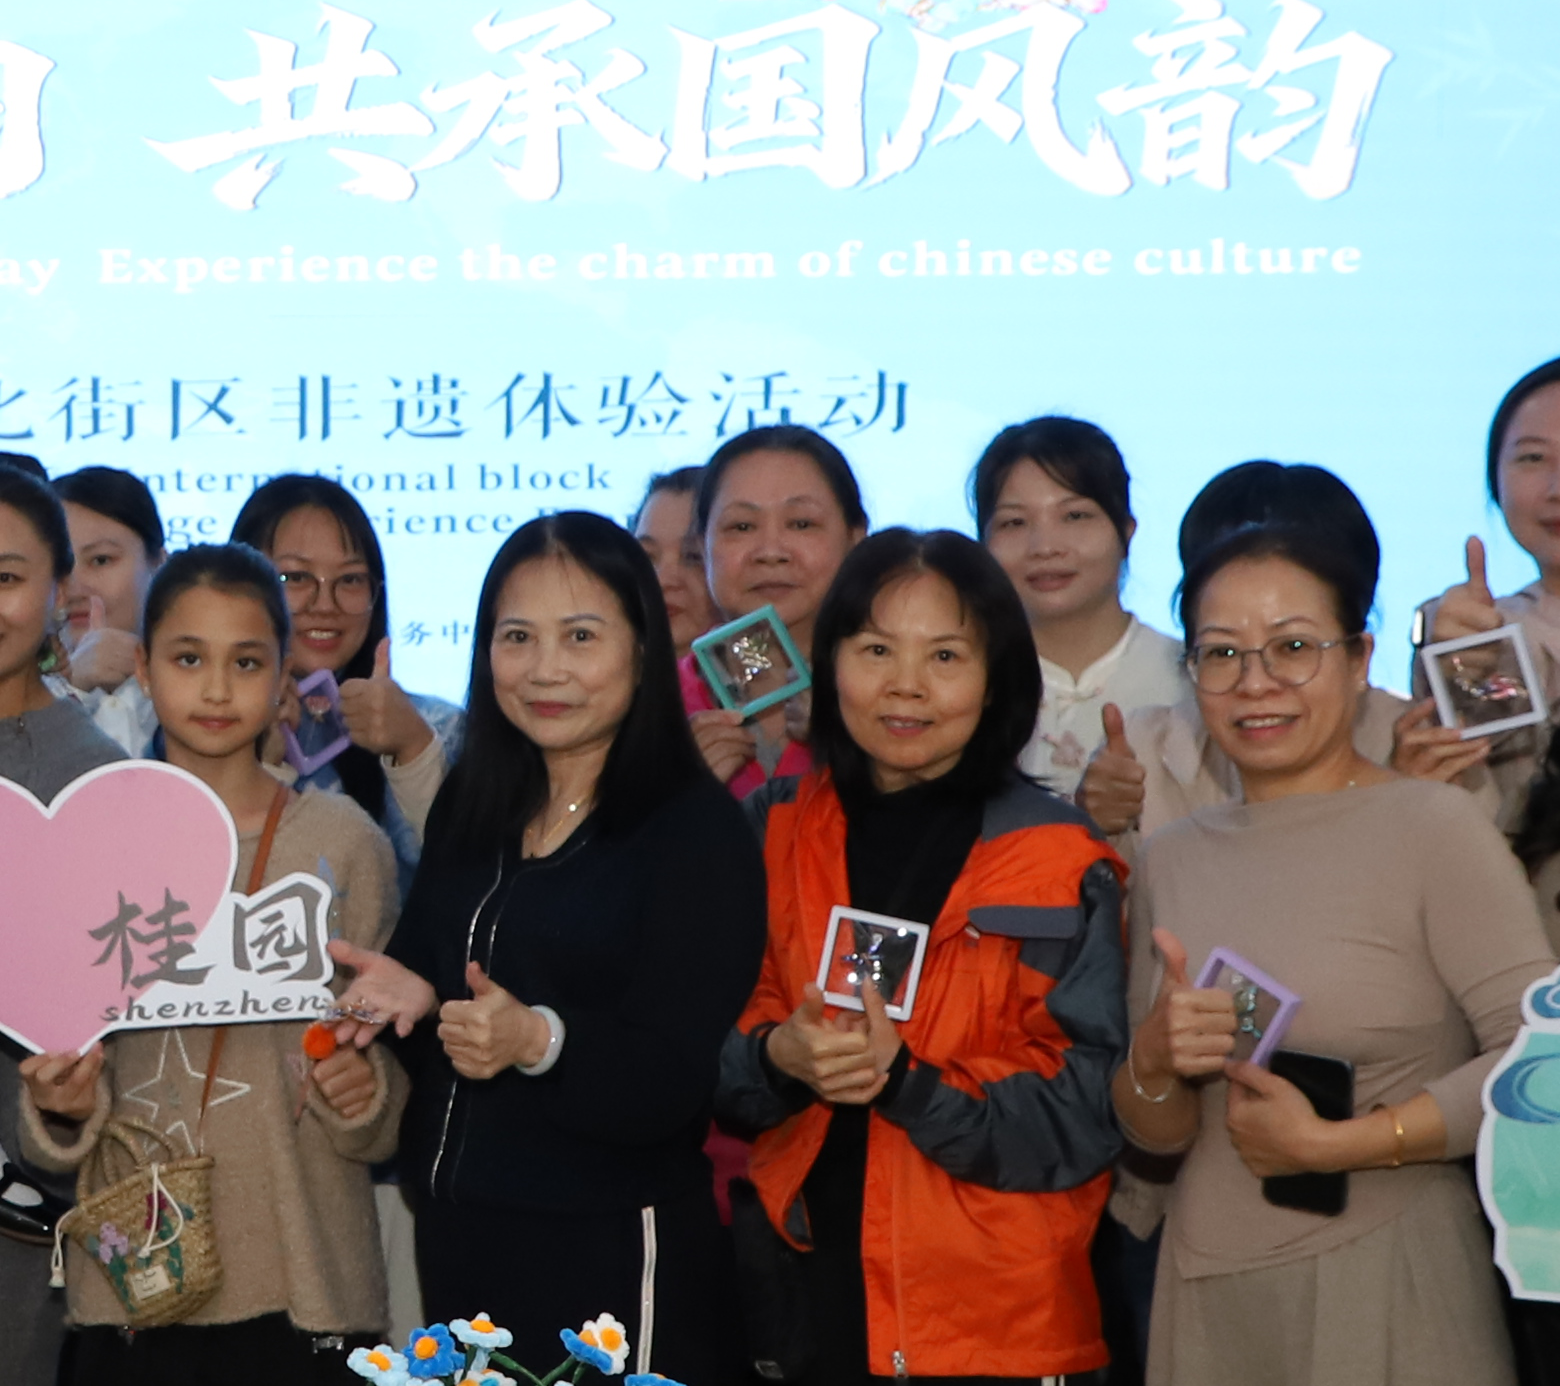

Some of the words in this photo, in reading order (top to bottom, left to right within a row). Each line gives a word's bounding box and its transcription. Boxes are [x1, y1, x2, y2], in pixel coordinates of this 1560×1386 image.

[98, 246, 439, 294] Experience
[460, 243, 559, 282] the
[577, 242, 777, 281] charm
[797, 239, 864, 280] of
[878, 239, 1114, 279] chinese
[1133, 237, 1363, 276] culture
[479, 462, 613, 491] block
[87, 880, 325, 991] 桂园
[99, 989, 327, 1024] shenzhen
